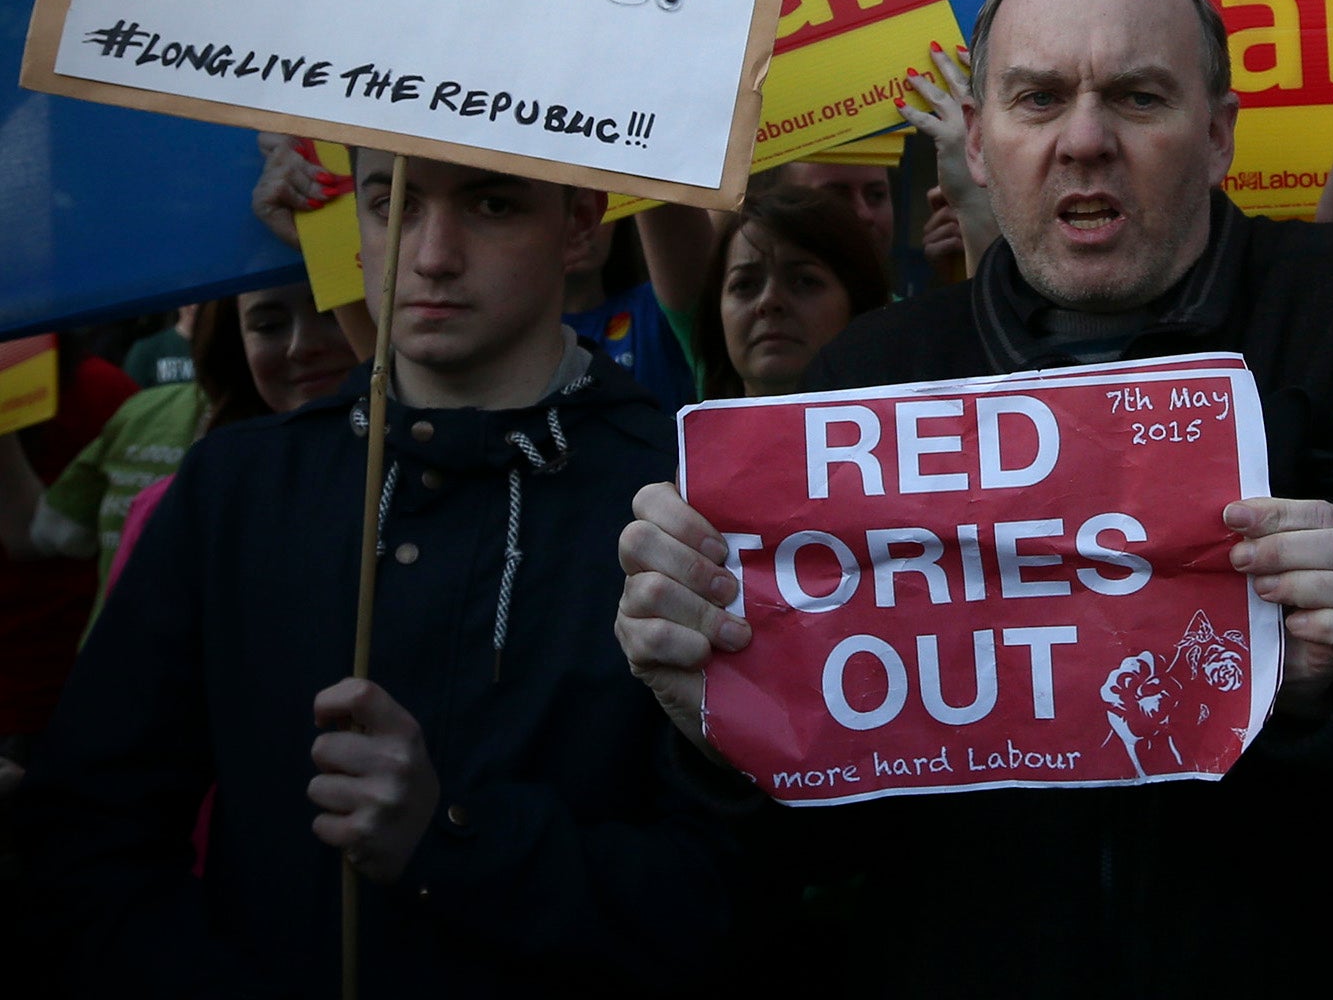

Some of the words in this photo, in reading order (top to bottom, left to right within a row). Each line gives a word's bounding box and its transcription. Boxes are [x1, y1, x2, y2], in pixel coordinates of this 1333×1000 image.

[339, 63, 423, 104] THE
[1106, 387, 1154, 414] 7th
[1168, 387, 1229, 420] May
[804, 394, 1061, 500] RED
[1131, 418, 1202, 445] 2015
[822, 625, 1078, 732] OUT
[773, 763, 861, 789] more
[873, 745, 954, 777] hard
[967, 738, 1082, 771] Labour
